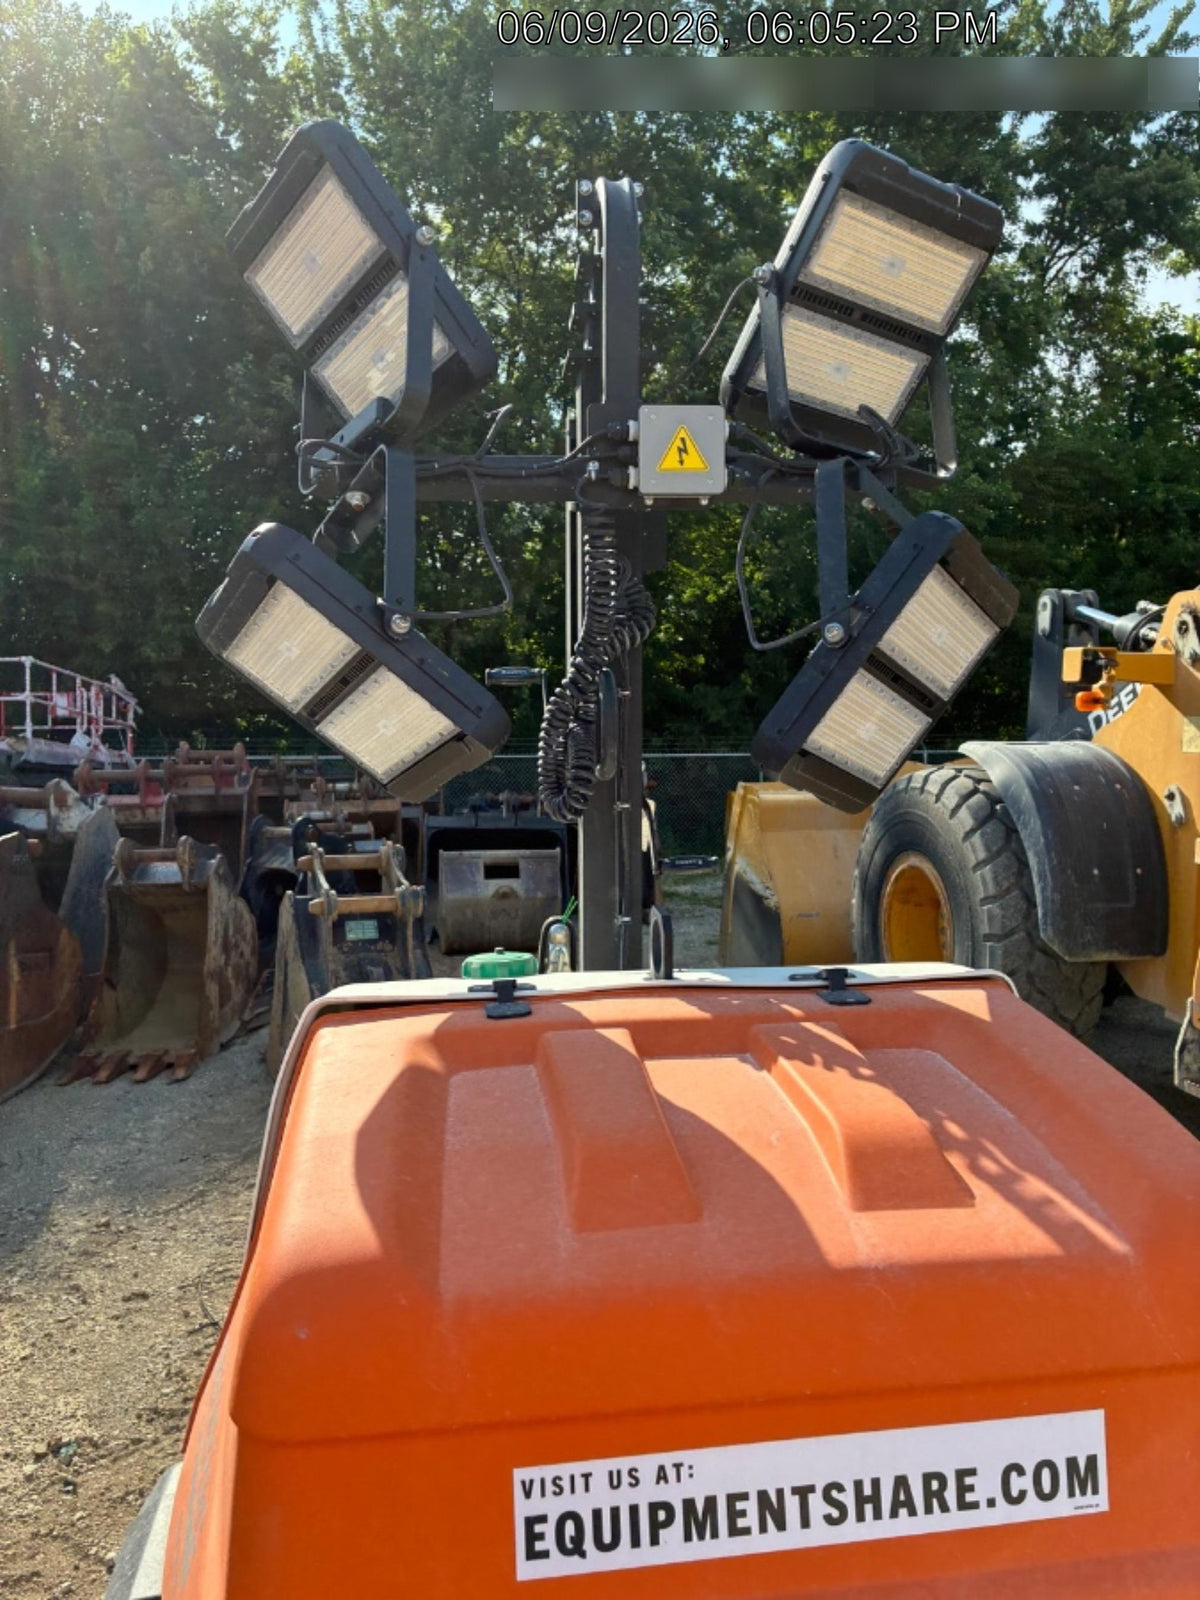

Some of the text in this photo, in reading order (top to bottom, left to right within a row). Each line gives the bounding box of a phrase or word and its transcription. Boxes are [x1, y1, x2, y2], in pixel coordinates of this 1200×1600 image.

[1088, 682, 1142, 734] DEE
[520, 1462, 696, 1500] VISIT US AT:
[523, 1454, 1100, 1562] EQUIPMENTSHARE.COM
